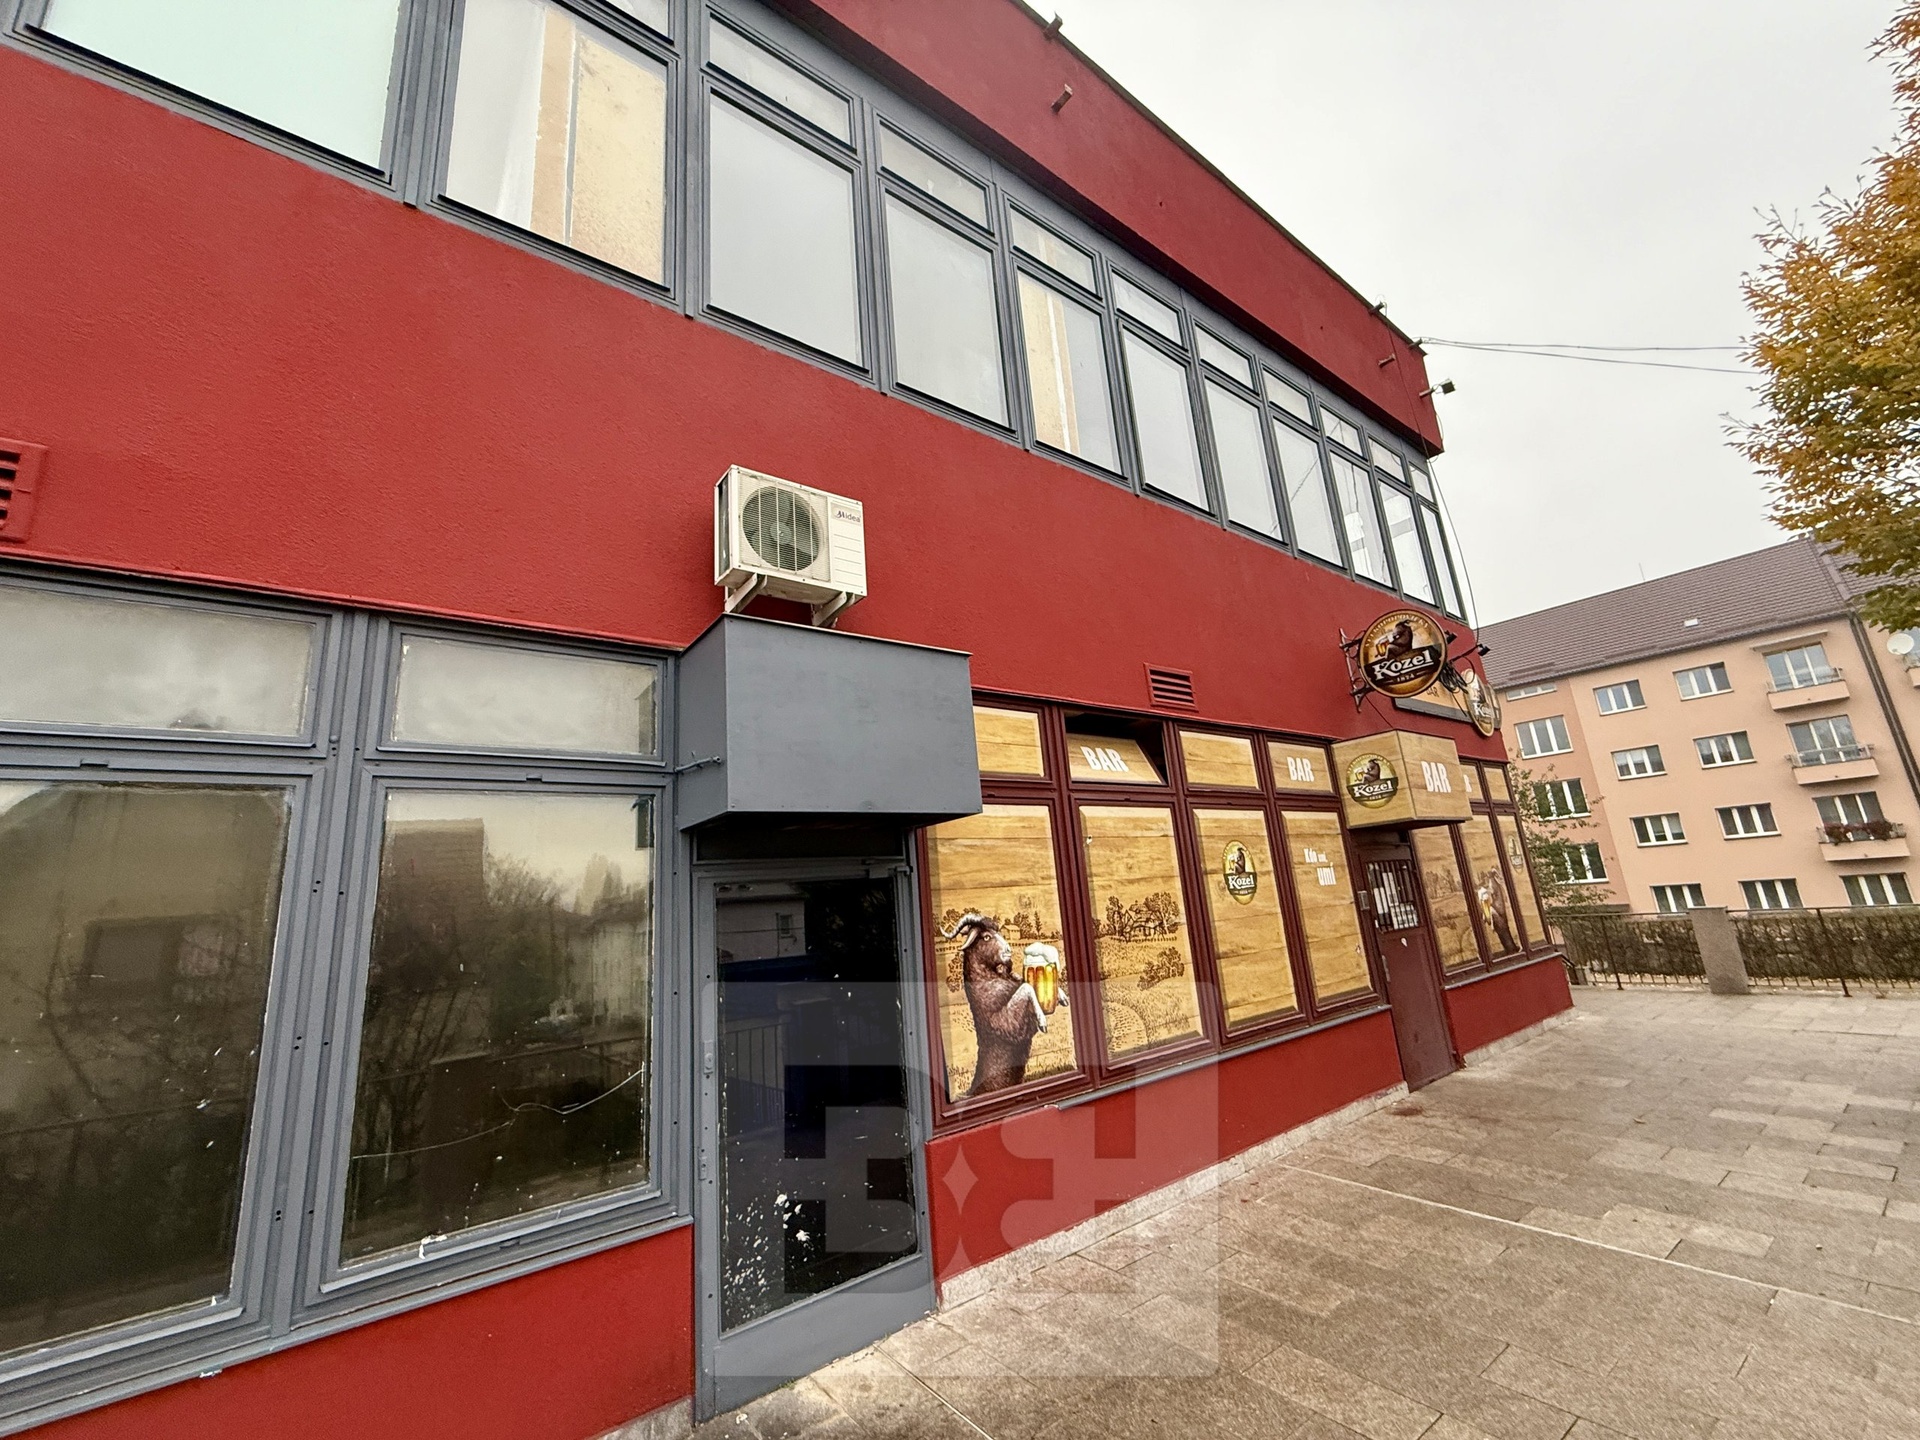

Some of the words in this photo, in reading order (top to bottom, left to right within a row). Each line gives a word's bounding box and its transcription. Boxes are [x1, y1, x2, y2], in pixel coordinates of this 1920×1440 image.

[836, 510, 861, 523] Midea
[1372, 650, 1434, 681] Kozel
[1080, 746, 1129, 772] BAR
[1287, 757, 1315, 782] BAR
[1353, 780, 1393, 798] Kozel
[1421, 761, 1452, 793] BAR
[1227, 874, 1255, 889] Kozel
[1317, 861, 1337, 886] umí
